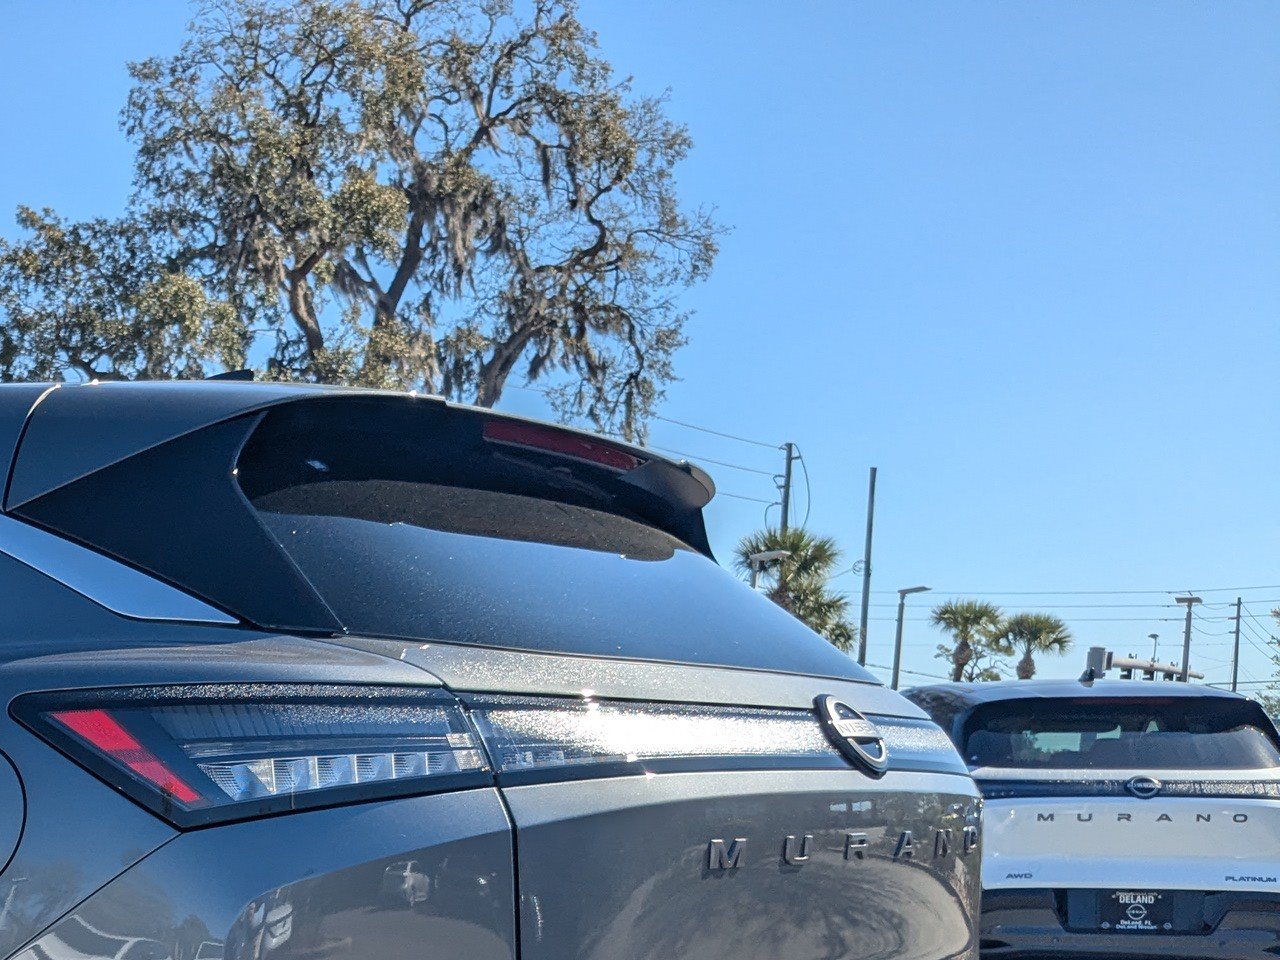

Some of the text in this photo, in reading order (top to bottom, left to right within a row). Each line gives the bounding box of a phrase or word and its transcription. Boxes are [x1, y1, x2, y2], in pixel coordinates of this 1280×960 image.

[1036, 813, 1249, 823] MURANO
[1005, 872, 1033, 880] AWD
[1224, 875, 1278, 883] PLATINUM
[1119, 895, 1155, 904] DELAND
